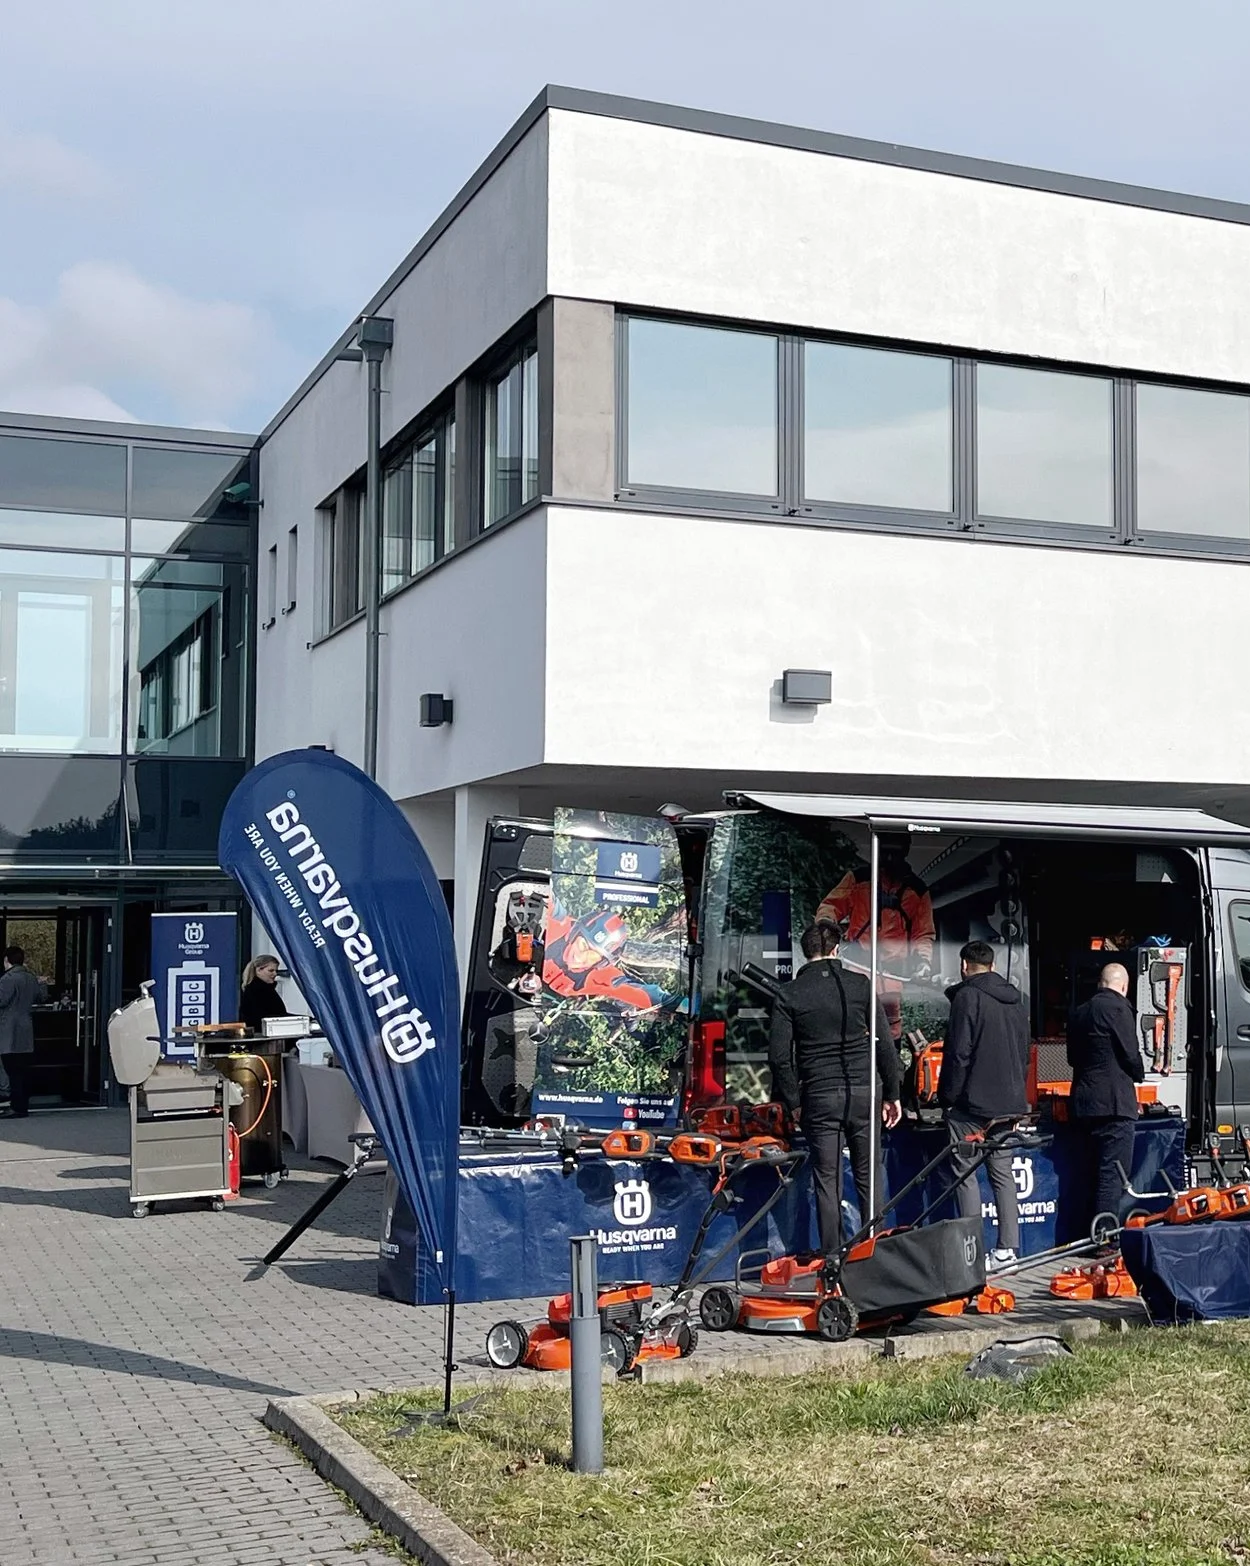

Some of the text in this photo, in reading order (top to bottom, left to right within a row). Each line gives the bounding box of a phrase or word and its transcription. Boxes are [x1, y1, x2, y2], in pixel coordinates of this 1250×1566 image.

[616, 1096, 638, 1106] Folgen
[639, 1097, 650, 1106] Sie
[638, 1109, 665, 1119] YouTube
[589, 1226, 677, 1245] Husqvarna
[602, 1246, 621, 1254] READY
[622, 1245, 640, 1253] WHEN
[640, 1243, 652, 1251] YOU
